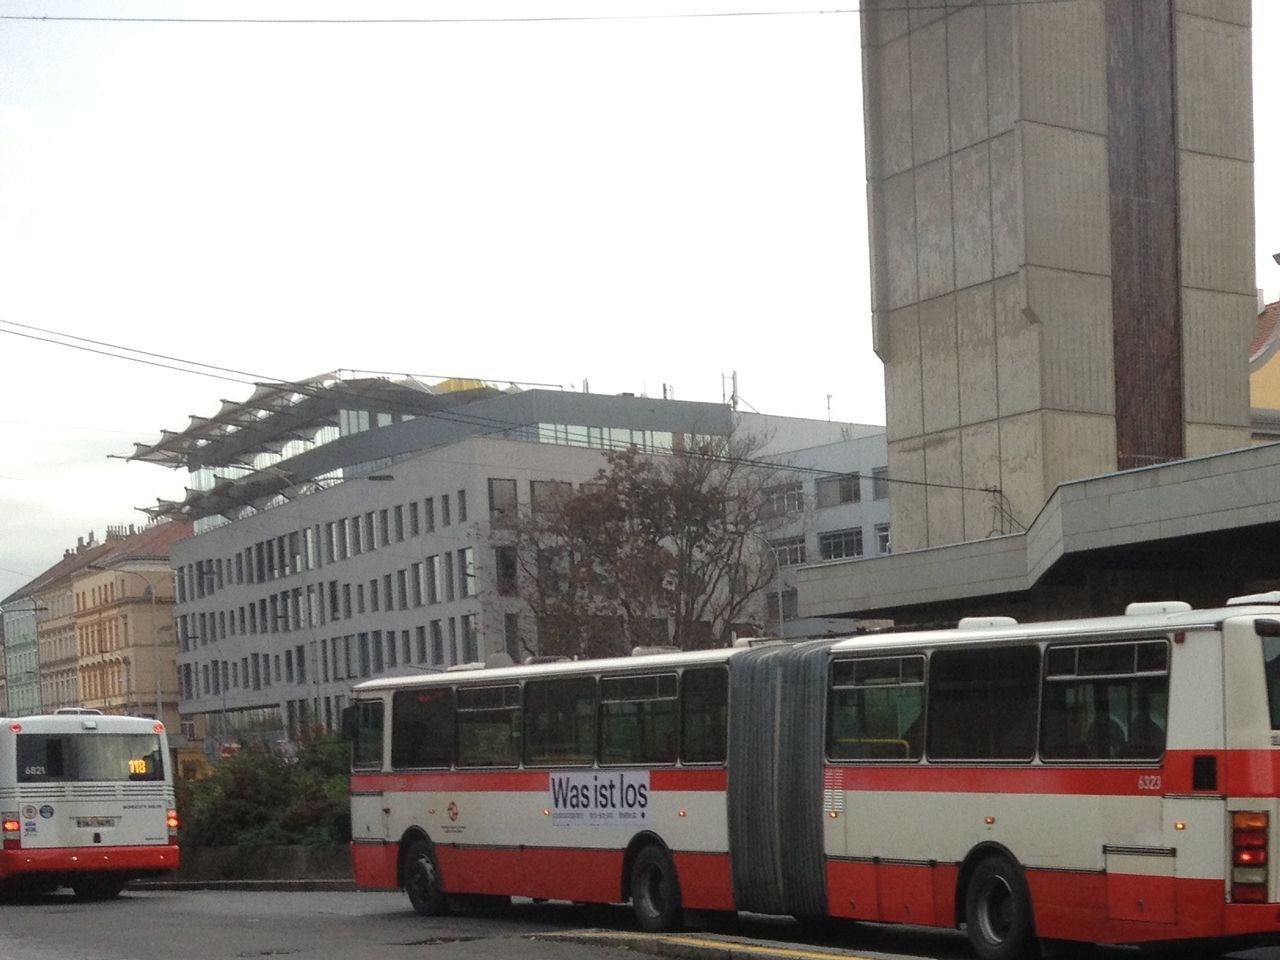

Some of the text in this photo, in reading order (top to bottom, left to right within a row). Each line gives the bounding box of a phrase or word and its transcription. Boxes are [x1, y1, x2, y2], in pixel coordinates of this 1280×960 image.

[25, 766, 46, 775] 6821
[128, 760, 147, 773] 118
[1138, 775, 1162, 790] 6323
[551, 773, 648, 809] Was ist los
